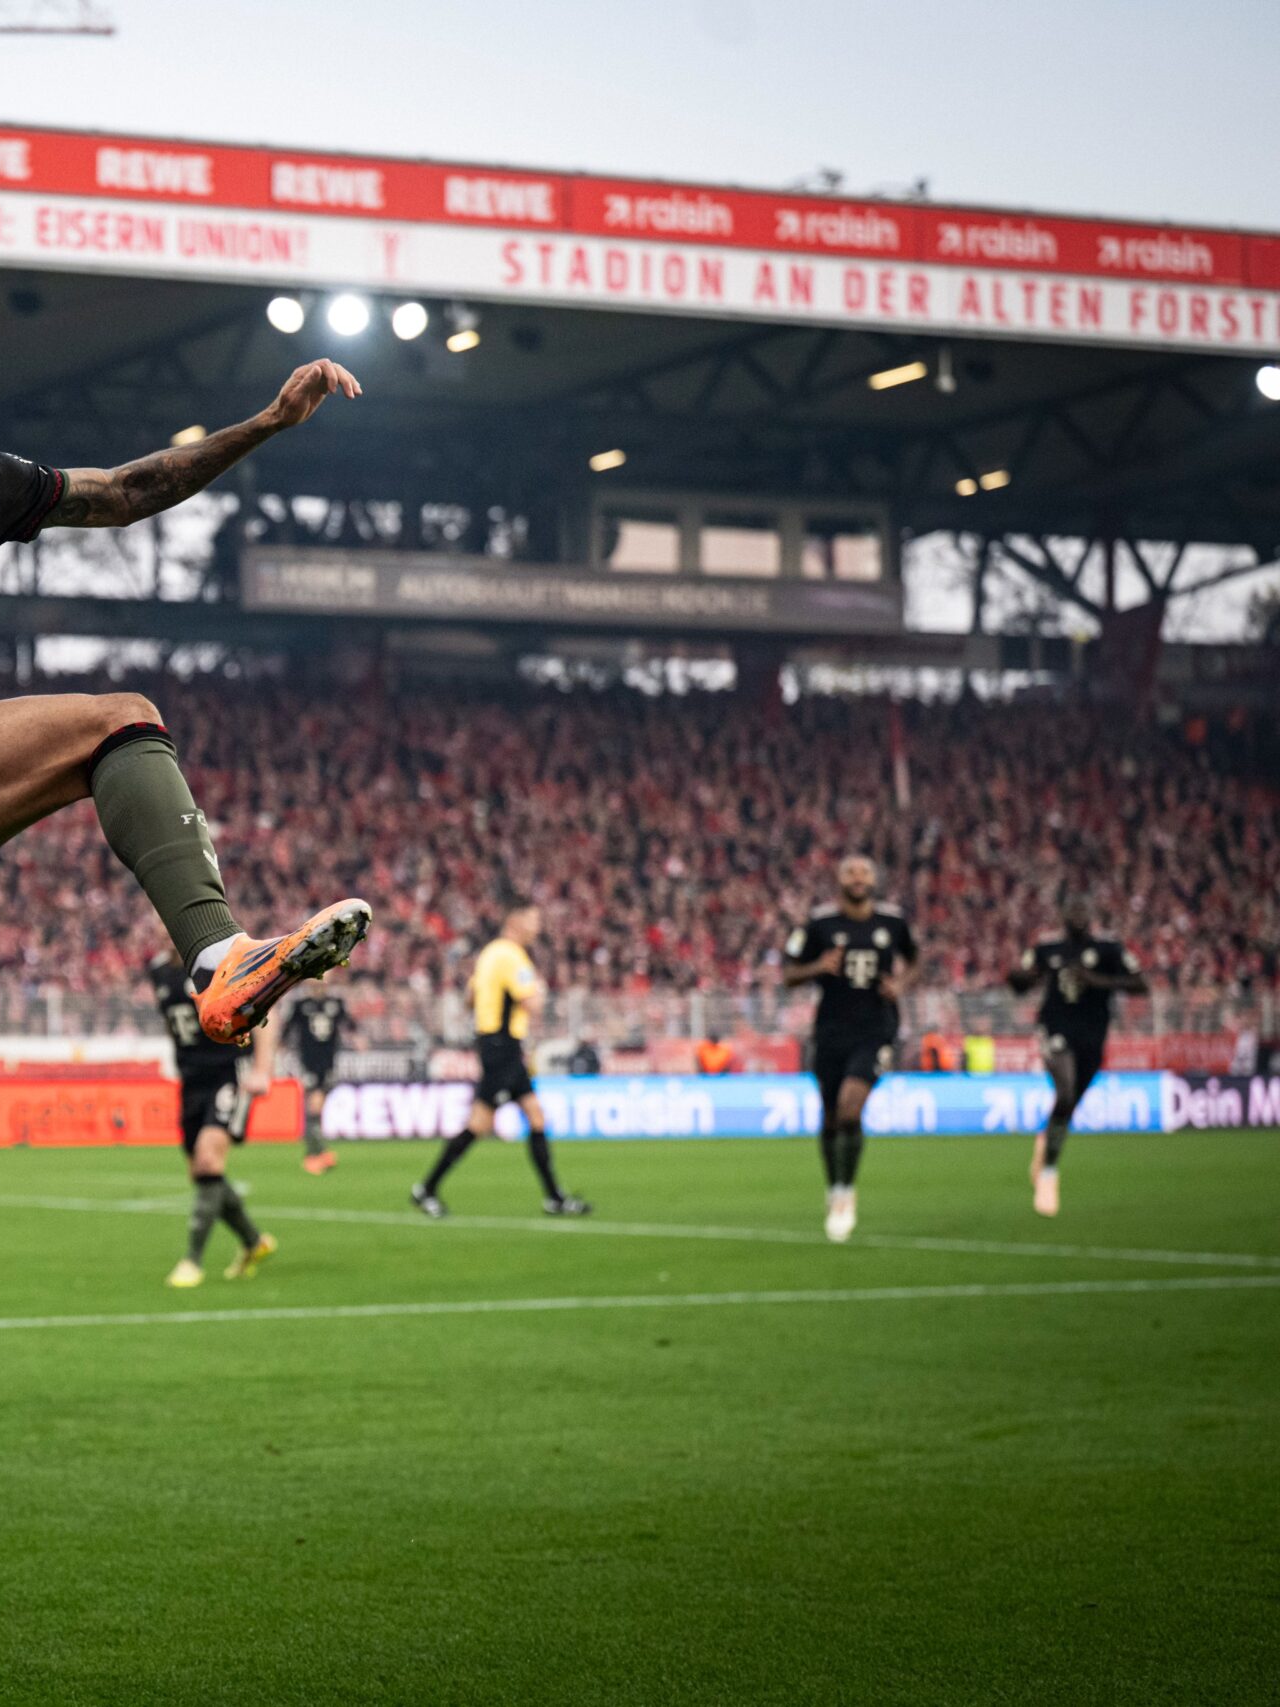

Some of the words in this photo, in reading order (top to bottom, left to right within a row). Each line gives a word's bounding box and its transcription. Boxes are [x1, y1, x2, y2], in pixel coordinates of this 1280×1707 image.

[96, 147, 214, 196] REWE
[270, 162, 385, 209] REWE
[445, 175, 556, 222] REWE
[635, 192, 734, 236] raisin
[33, 206, 166, 254] EISERN
[177, 219, 308, 267] UNION!
[805, 206, 899, 251] raisin
[964, 218, 1057, 263] raisin
[1124, 232, 1213, 276] raisin
[501, 240, 726, 301] STADION
[753, 260, 814, 306] AN
[843, 266, 931, 317] DER
[958, 275, 1104, 328] ALTEN
[1129, 287, 1280, 341] FORST
[574, 1079, 715, 1136] raisin
[1161, 1074, 1242, 1131] Dein
